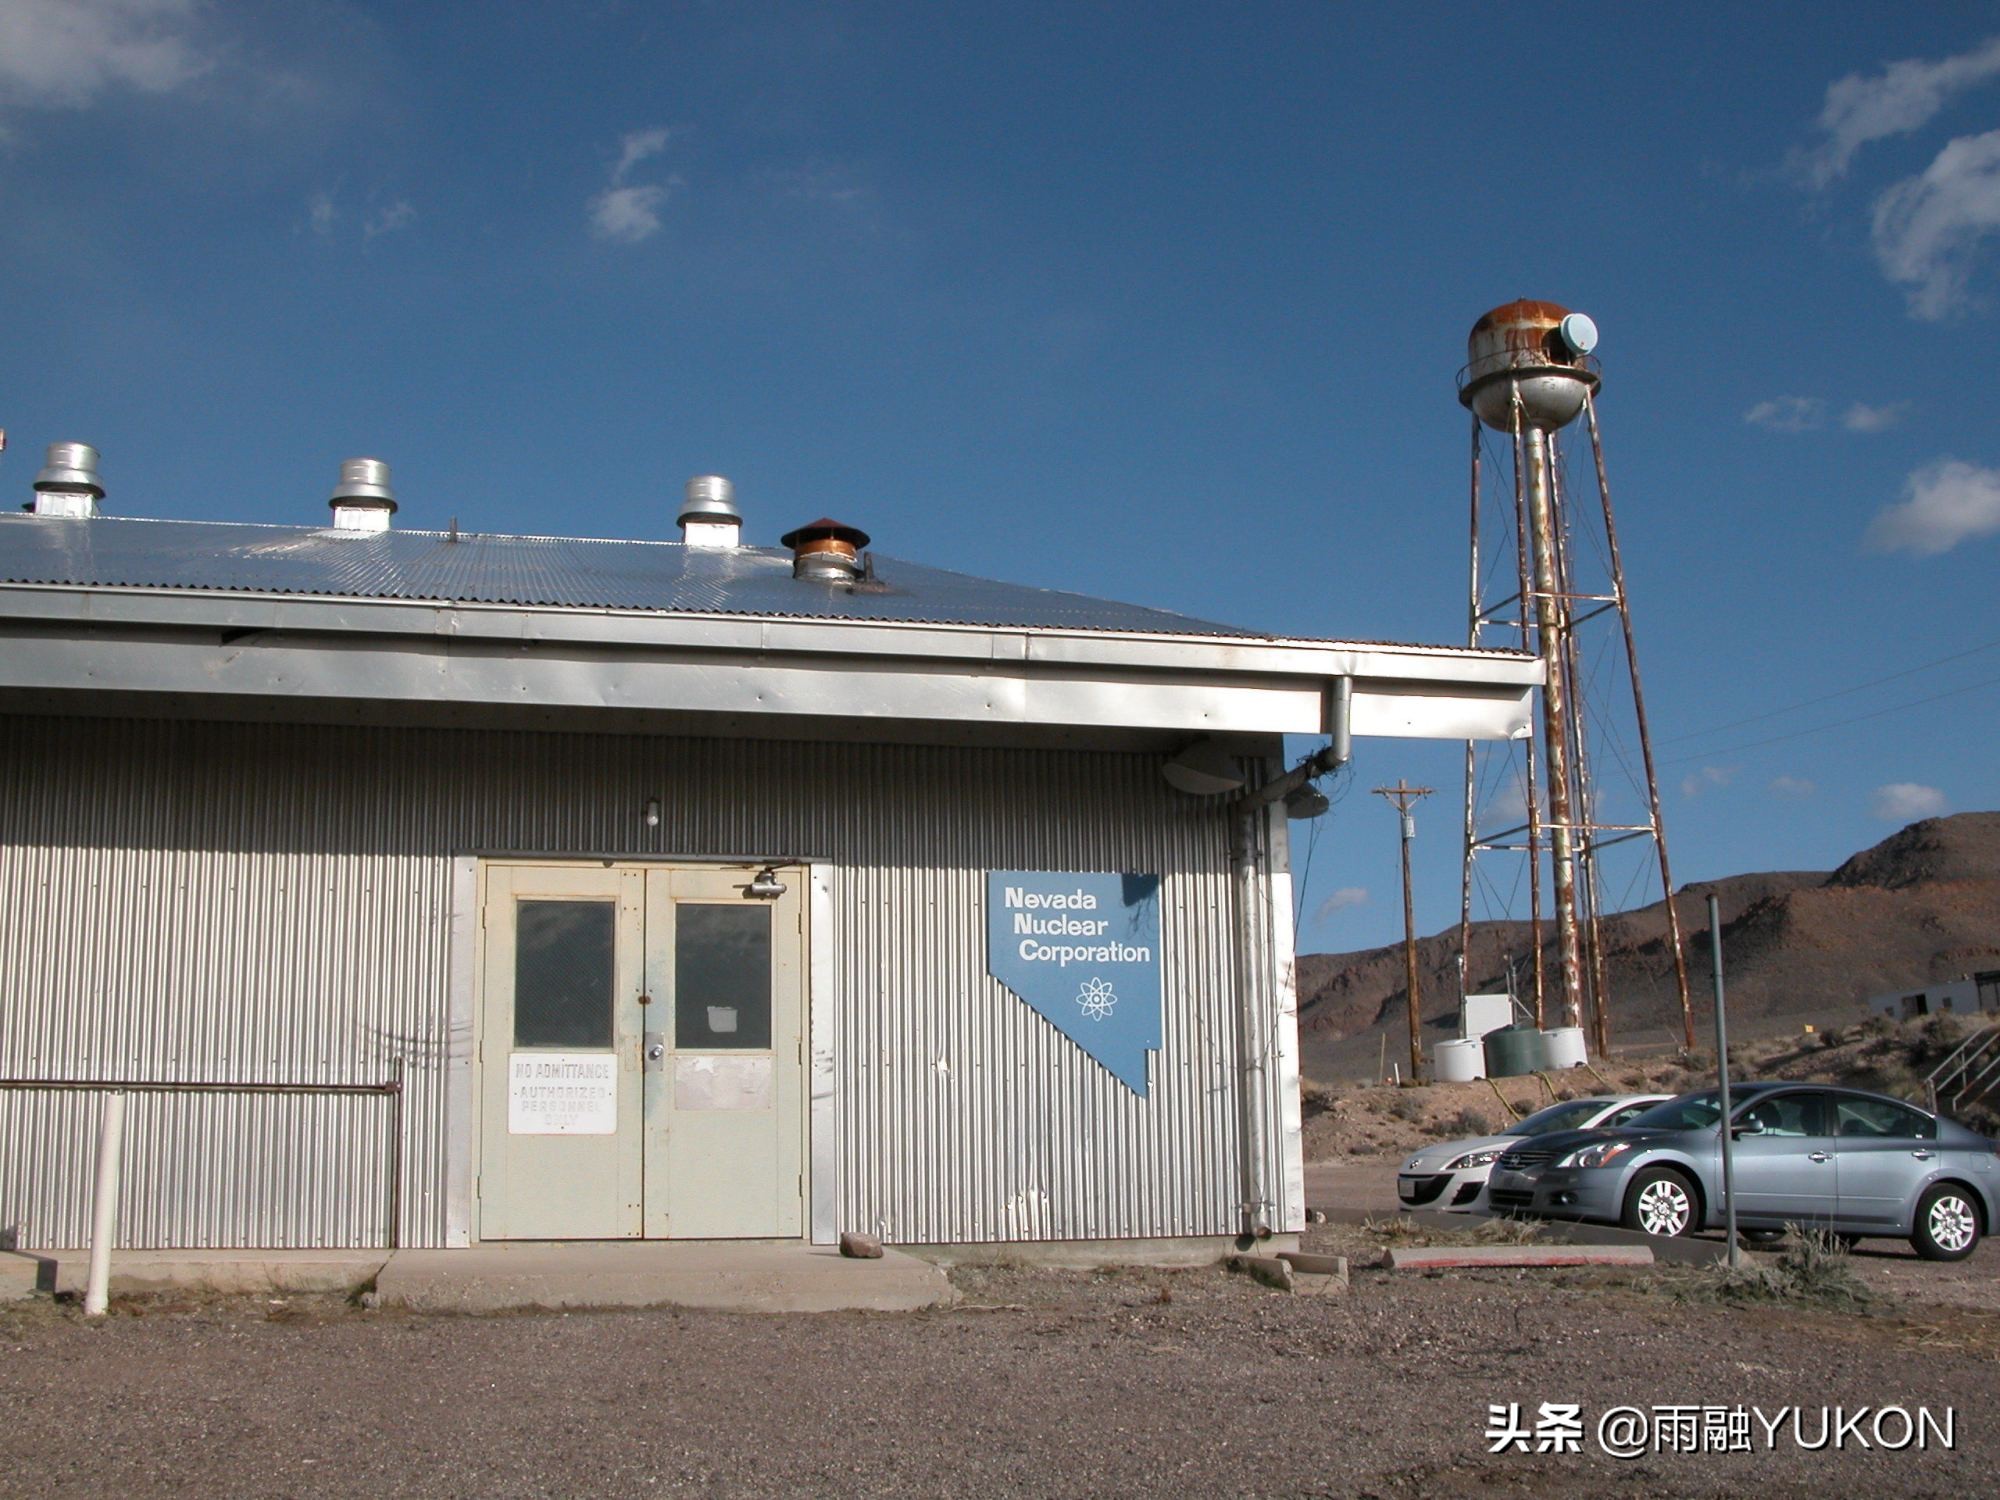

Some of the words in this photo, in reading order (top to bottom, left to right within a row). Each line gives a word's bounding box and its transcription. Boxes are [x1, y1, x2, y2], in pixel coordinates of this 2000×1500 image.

[1004, 887, 1097, 910] Nevada
[1013, 913, 1109, 936] Nuclear
[1018, 939, 1151, 967] Corporation
[515, 1063, 533, 1079] NO
[535, 1063, 610, 1079] ADMITTANCE
[519, 1086, 606, 1099] AUTHORIZED
